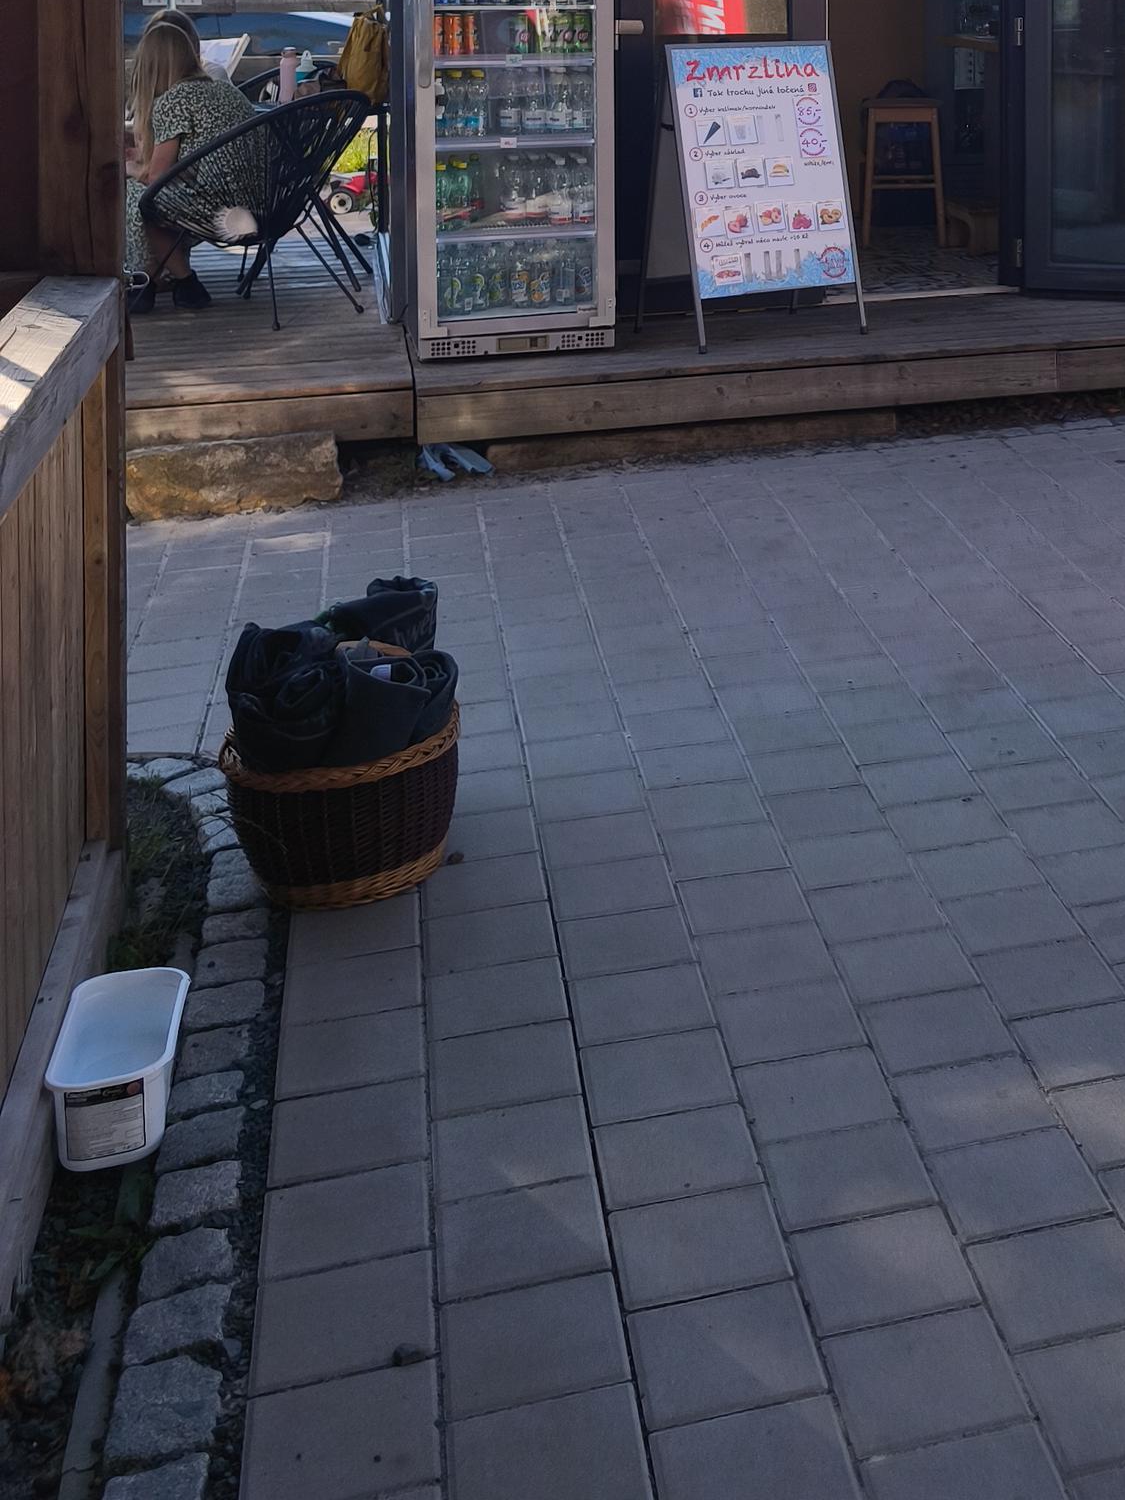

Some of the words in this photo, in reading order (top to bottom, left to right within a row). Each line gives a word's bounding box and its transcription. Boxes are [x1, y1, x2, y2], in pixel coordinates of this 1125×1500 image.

[686, 55, 820, 83] Zmrzlina
[707, 89, 723, 97] Tak
[726, 88, 754, 96] trochu
[757, 88, 774, 98] jiná
[777, 85, 805, 94] točená
[801, 138, 828, 147] 40,-
